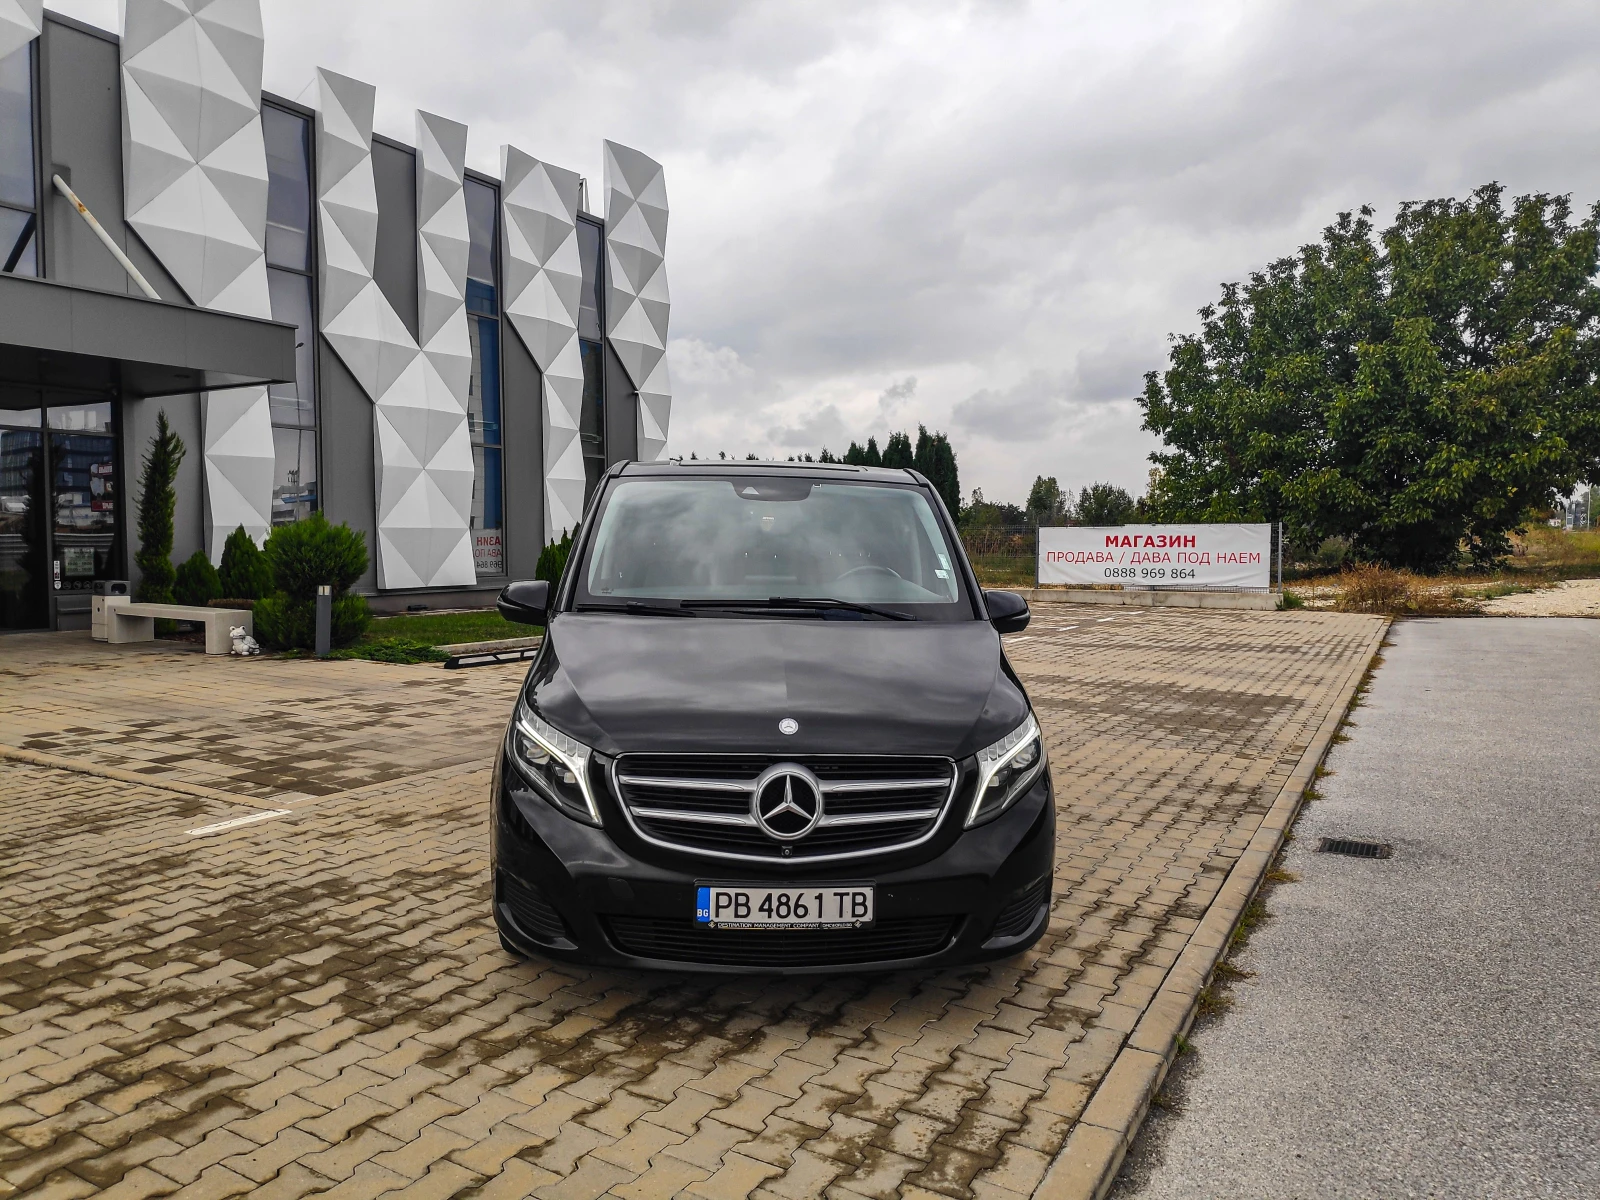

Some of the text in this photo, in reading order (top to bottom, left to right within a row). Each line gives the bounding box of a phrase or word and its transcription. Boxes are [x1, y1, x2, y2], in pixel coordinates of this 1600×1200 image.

[1105, 535, 1196, 548] МАГАЗИН
[1046, 551, 1261, 566] ПРОДАВА / ДАВА ПОД НАЕМ
[1104, 567, 1196, 579] 0888 969 864
[715, 892, 868, 919] PB 4861 TB
[697, 909, 709, 917] BG
